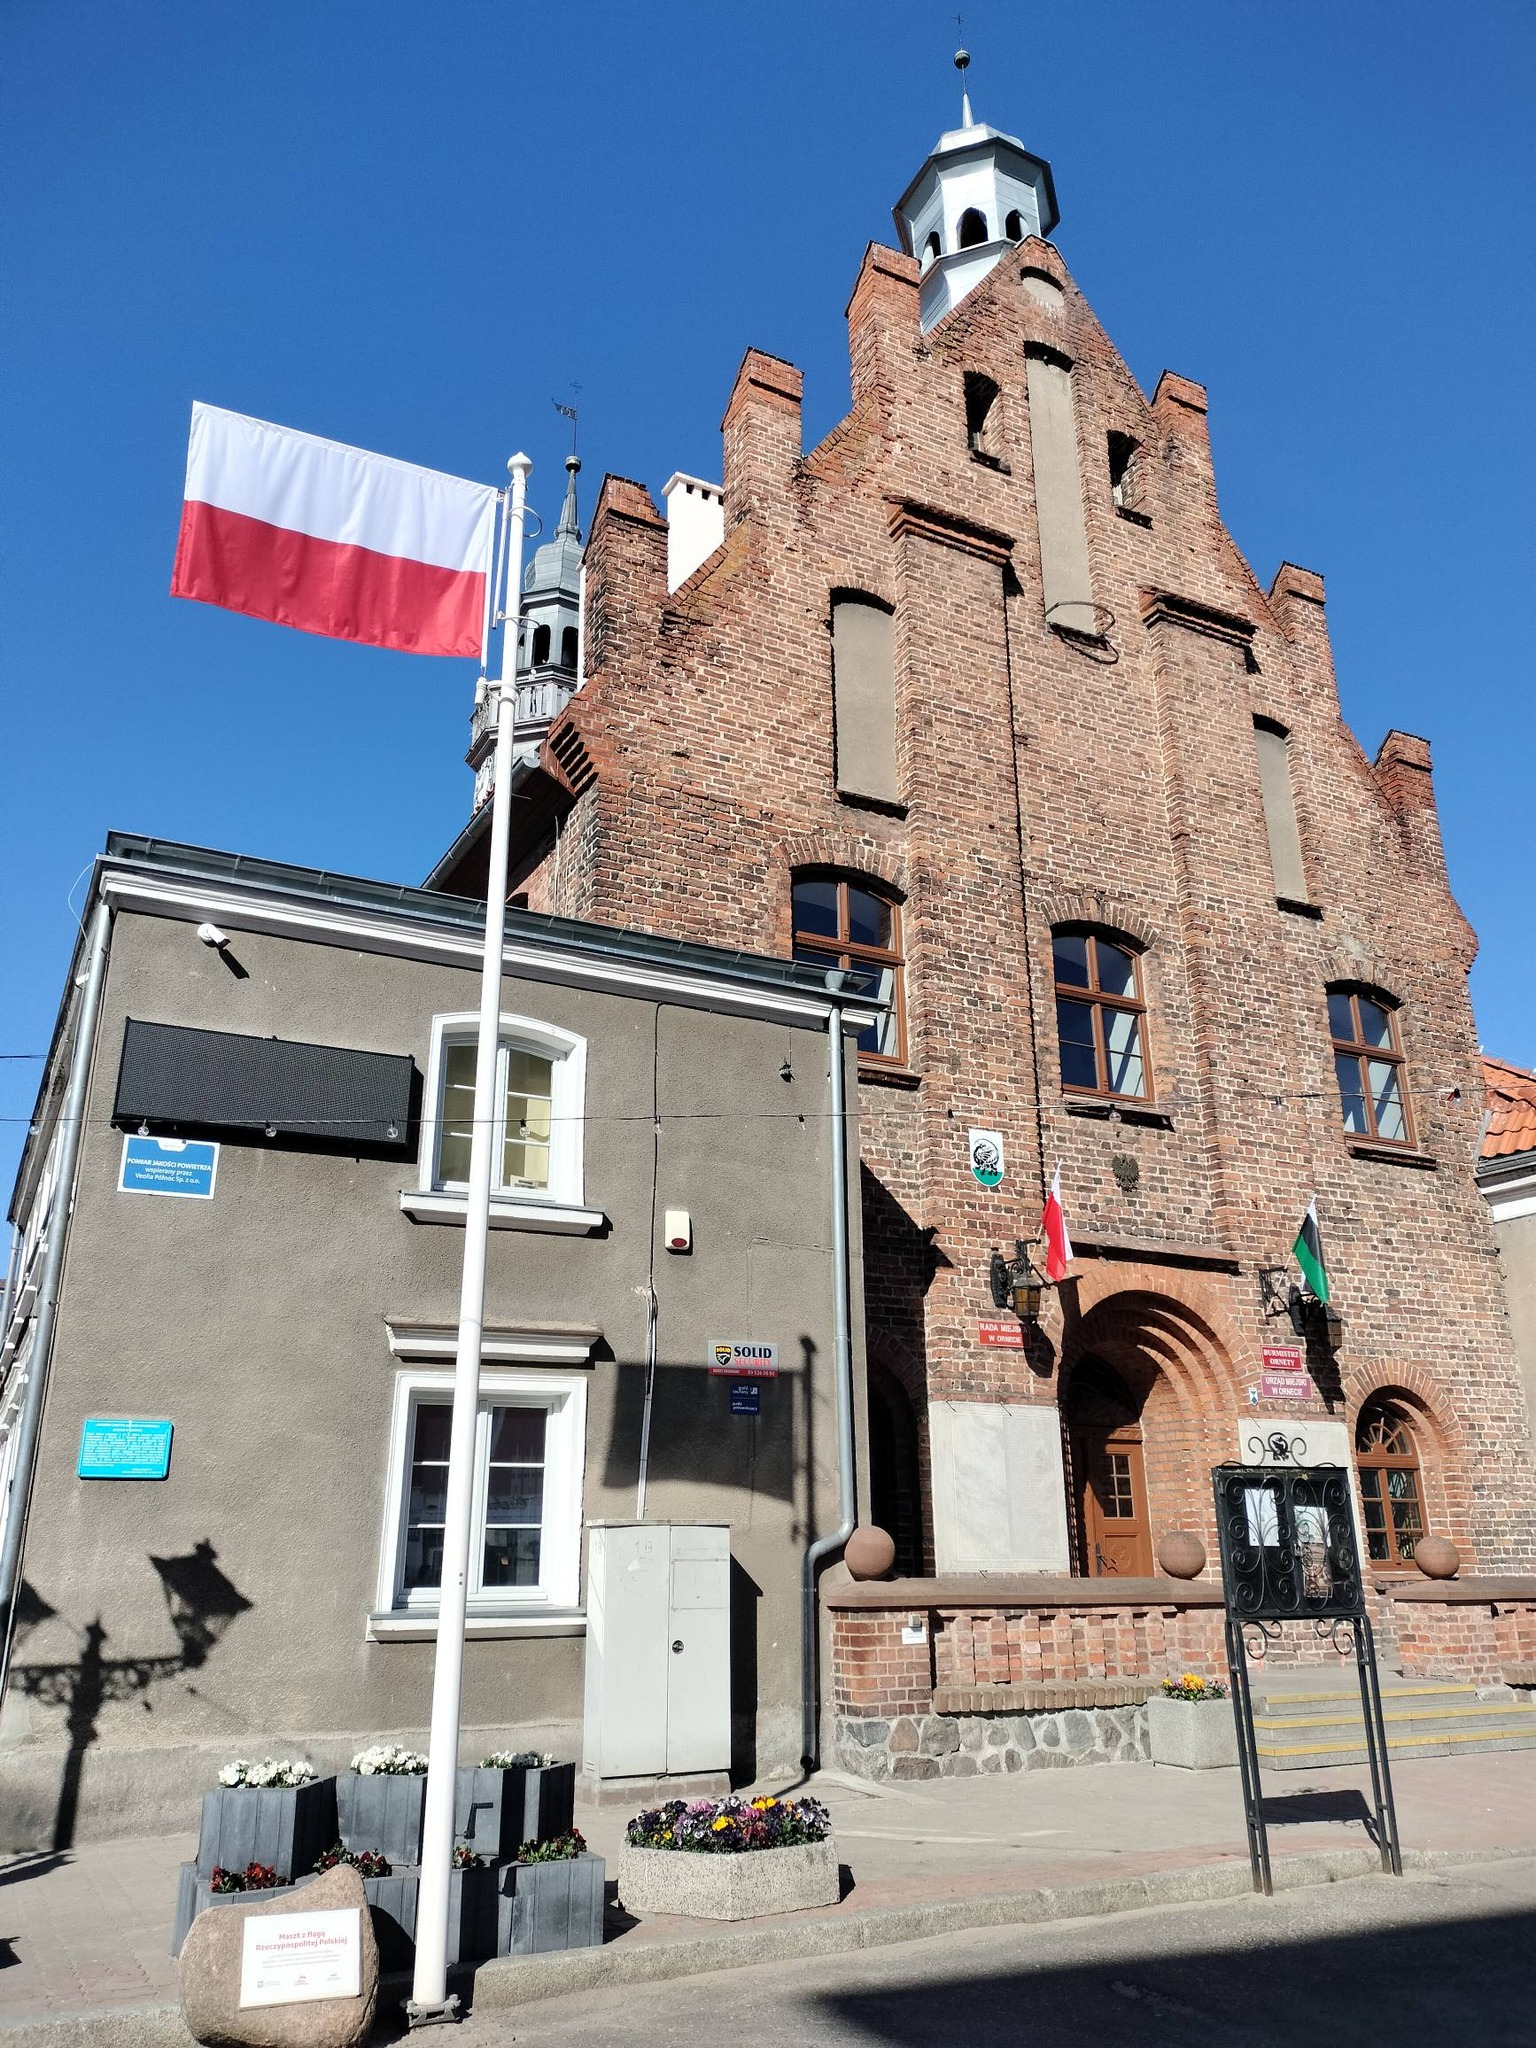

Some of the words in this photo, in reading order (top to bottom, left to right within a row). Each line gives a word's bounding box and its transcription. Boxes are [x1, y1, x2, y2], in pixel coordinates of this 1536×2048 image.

[127, 1157, 152, 1166] POMIAR
[152, 1159, 176, 1168] JAKOŚCI
[177, 1162, 212, 1171] POWIETRZA
[144, 1167, 176, 1176] wspierany
[980, 1323, 998, 1332] RADA
[734, 1346, 772, 1358] SOLID
[1263, 1349, 1299, 1358] BURMISTRZ
[1270, 1358, 1295, 1366] ORNETY
[1265, 1377, 1285, 1386] URZĄD
[1286, 1378, 1307, 1386] MIEJSKI
[1278, 1387, 1303, 1396] ORNECIE
[307, 1930, 326, 1938] flagą
[255, 1938, 318, 1951] Rzeczypospolitej
[319, 1936, 348, 1945] Polskiej
